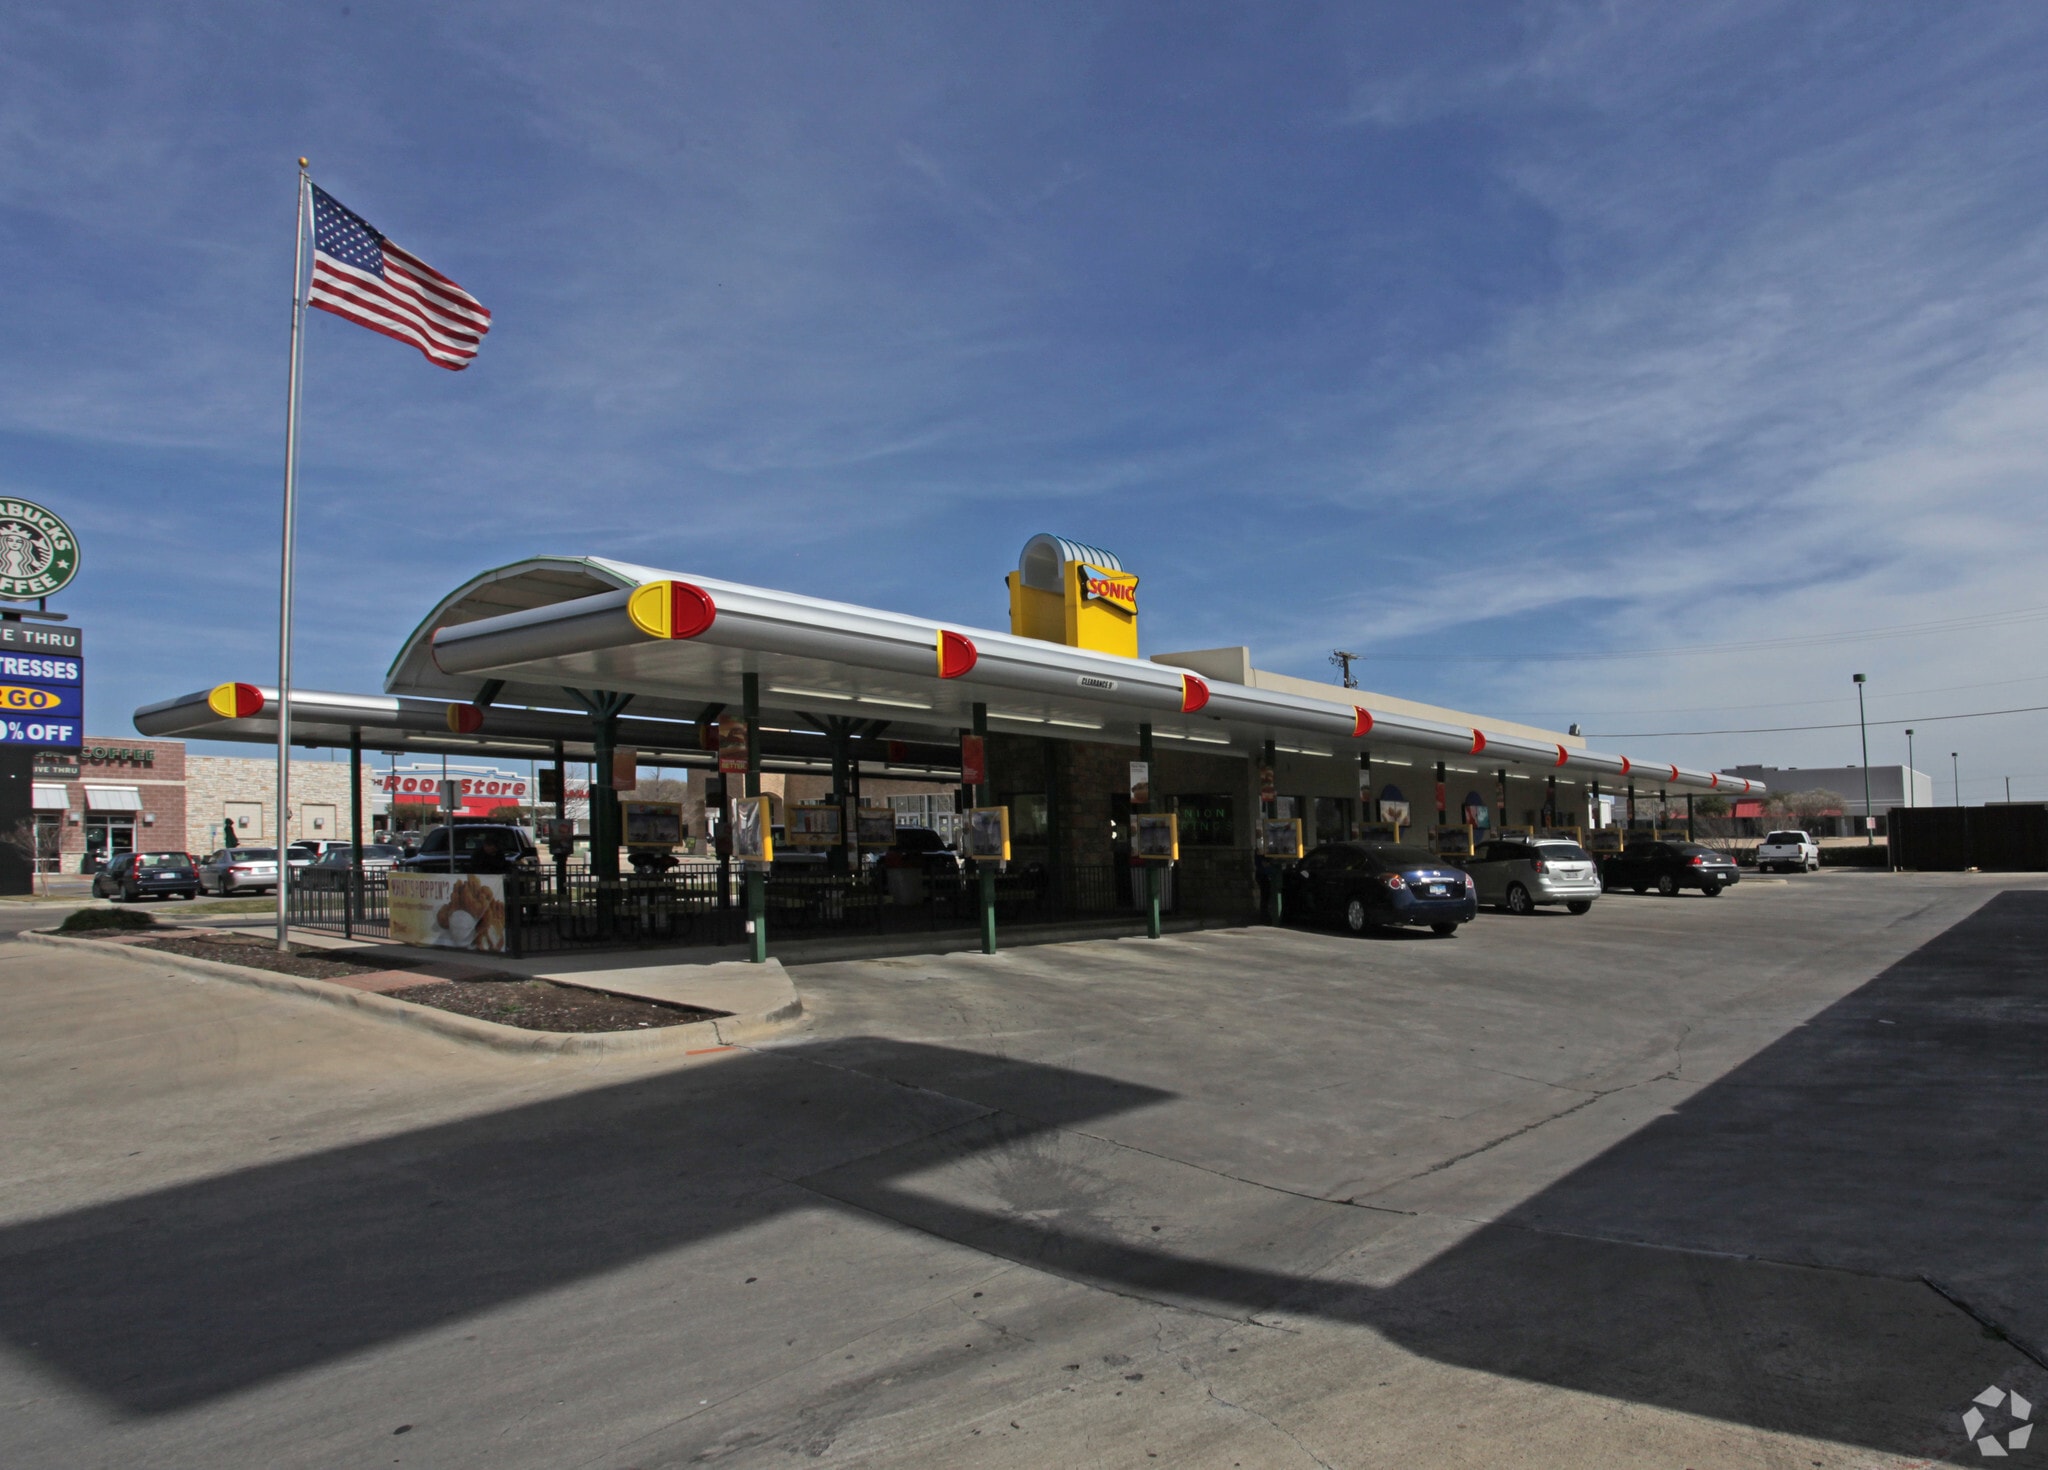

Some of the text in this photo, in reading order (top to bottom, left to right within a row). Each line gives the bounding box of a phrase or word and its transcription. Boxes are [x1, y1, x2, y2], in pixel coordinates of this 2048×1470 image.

[1089, 577, 1135, 602] SONIC
[22, 630, 76, 648] THRU
[1081, 677, 1108, 689] CLEARANCE
[8, 689, 47, 708] GO
[26, 723, 73, 742] OFF
[81, 746, 155, 761] COFFEE
[53, 766, 78, 774] THRU
[1183, 808, 1225, 818] NION
